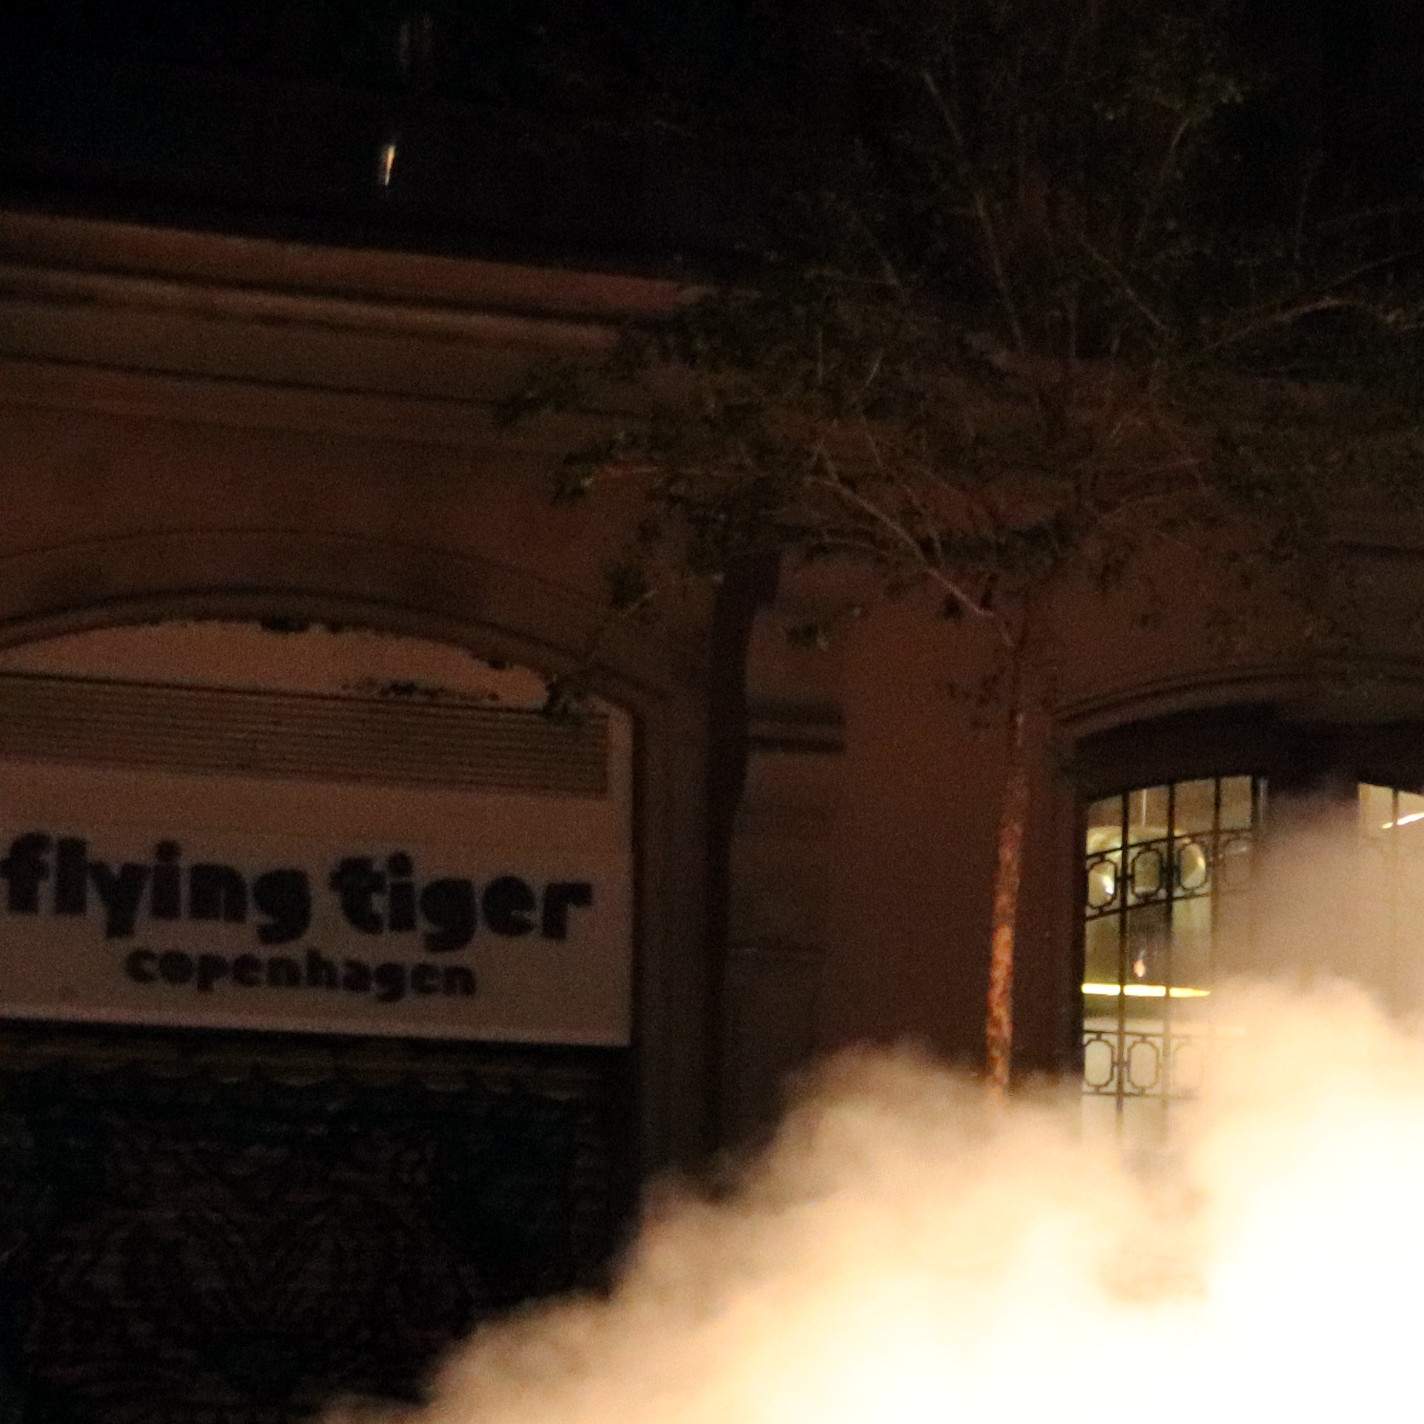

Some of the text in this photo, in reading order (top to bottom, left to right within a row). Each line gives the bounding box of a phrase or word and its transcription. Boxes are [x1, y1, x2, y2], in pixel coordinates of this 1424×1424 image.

[1, 831, 595, 953] flying tiger
[124, 948, 478, 1002] copenhagen
